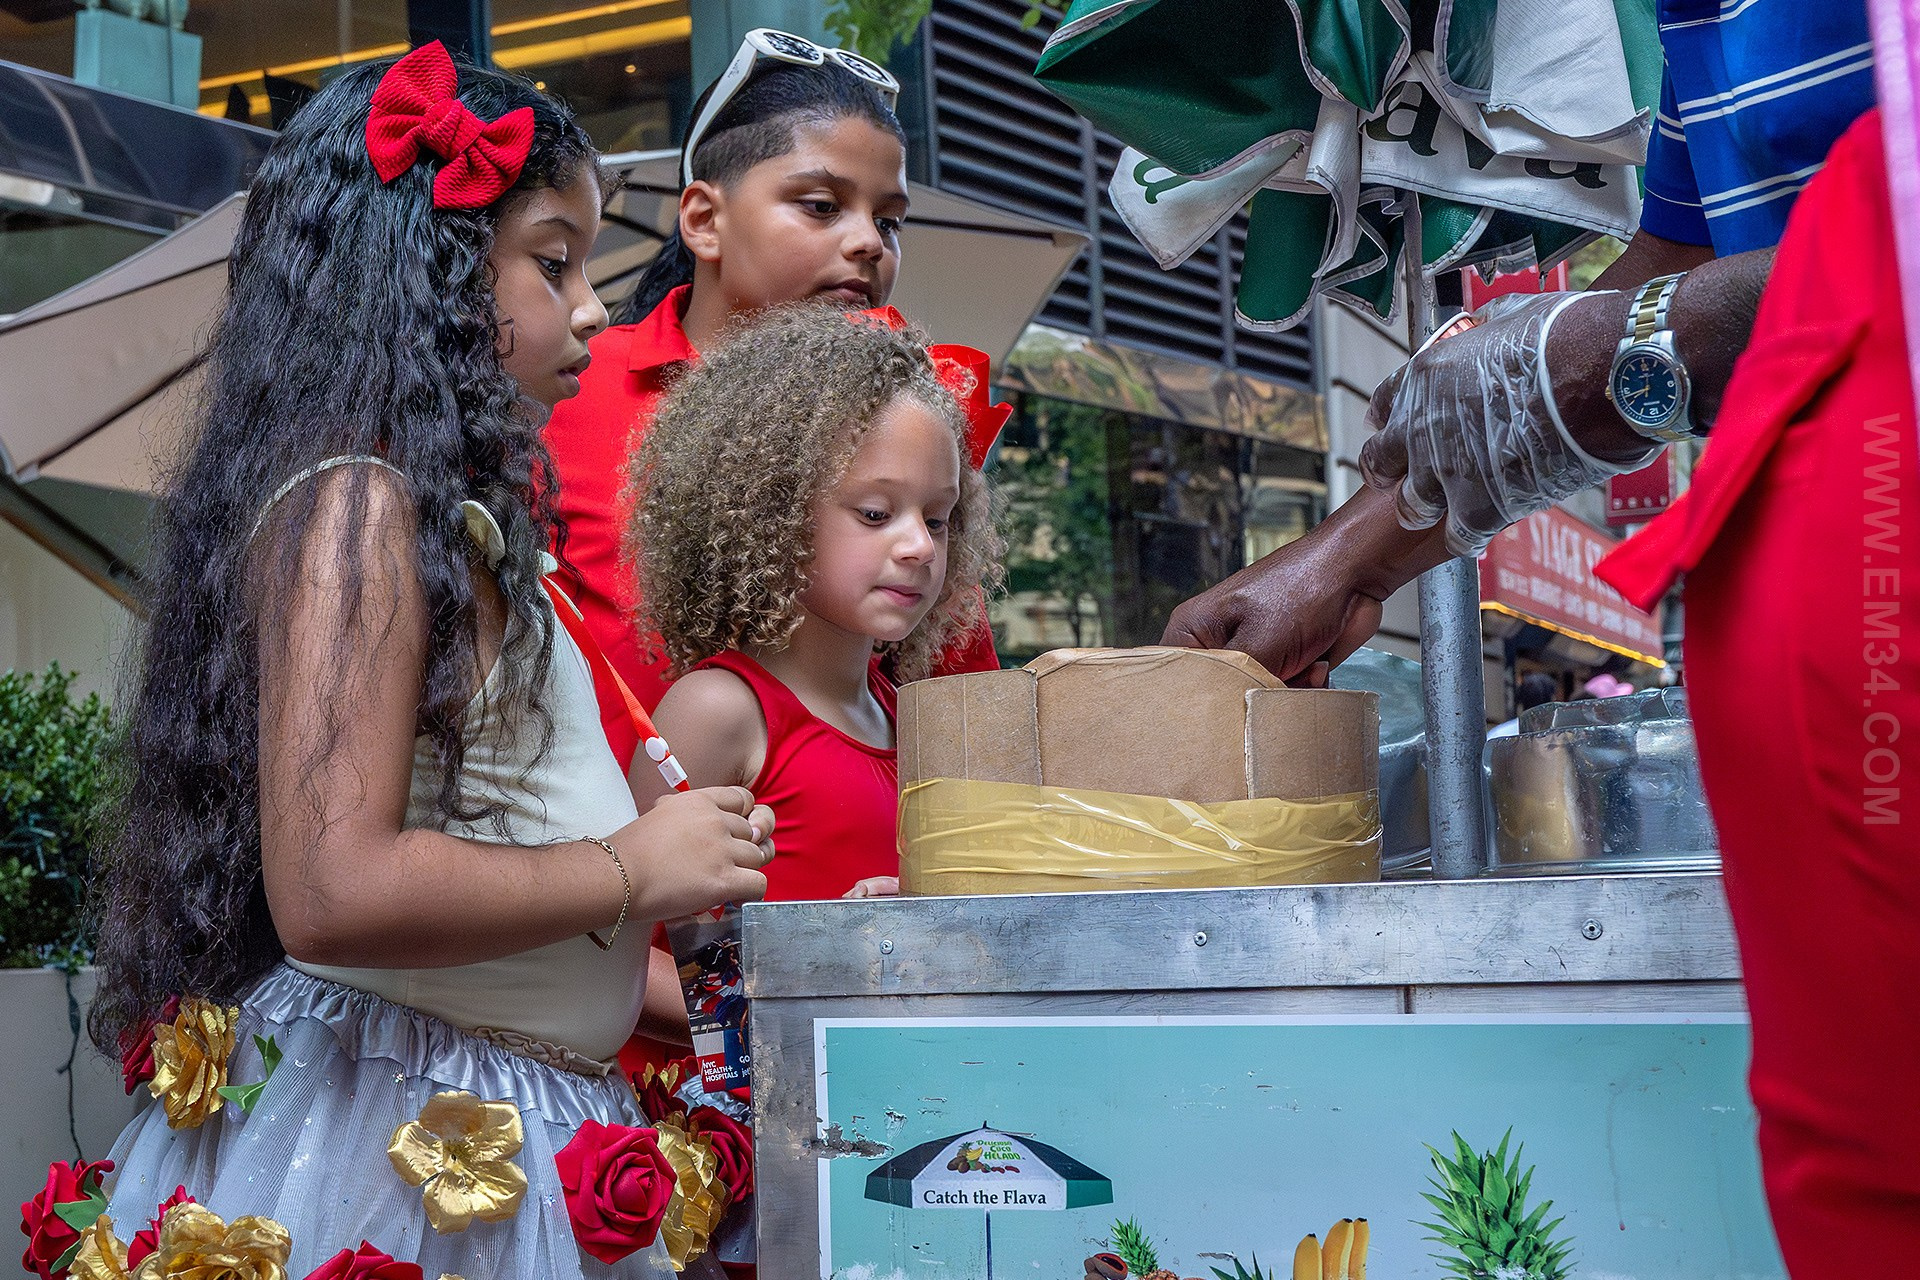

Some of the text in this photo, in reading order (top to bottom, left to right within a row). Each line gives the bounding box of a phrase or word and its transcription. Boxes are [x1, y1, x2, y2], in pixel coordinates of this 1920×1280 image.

[703, 1060, 716, 1069] NYC
[704, 1065, 733, 1075] HEALTH+
[705, 1070, 738, 1082] HOSPITALS
[984, 1151, 1021, 1160] HELADO
[923, 1189, 1047, 1204] Catch the Flava
